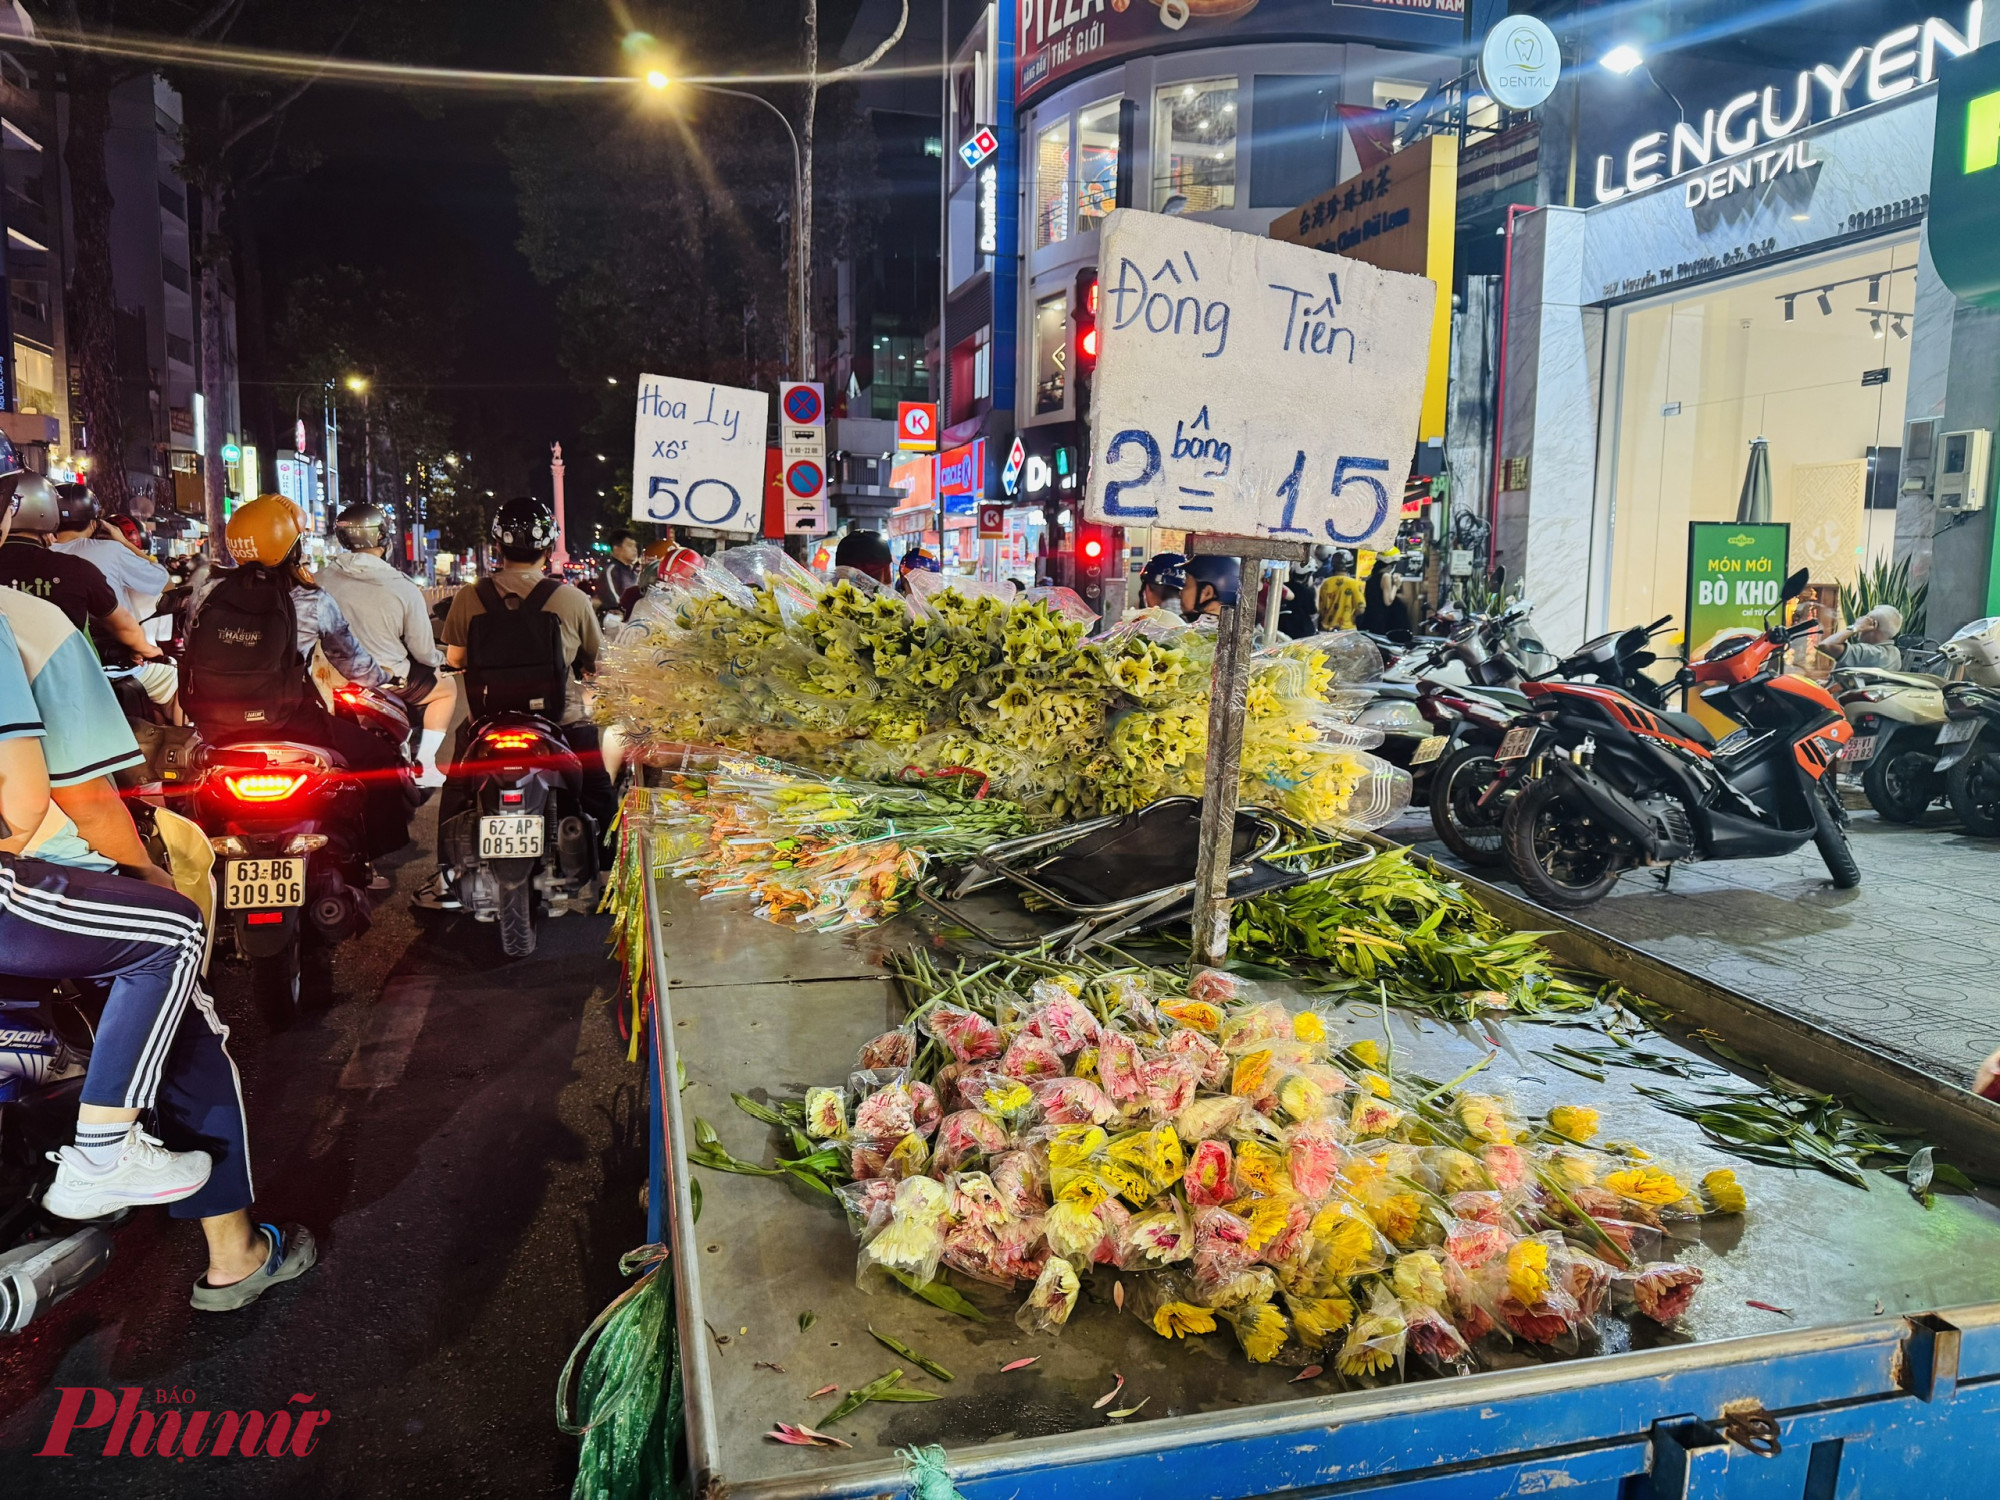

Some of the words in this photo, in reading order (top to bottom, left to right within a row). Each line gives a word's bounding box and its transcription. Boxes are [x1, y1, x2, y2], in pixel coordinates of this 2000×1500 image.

[1021, 0, 1104, 57] PIZZ
[1051, 26, 1073, 68] THẾ
[1076, 20, 1105, 56] GIỚI
[1499, 76, 1551, 88] DENTAL
[1685, 140, 1819, 208] DENTAL
[1108, 250, 1231, 358] Đồng
[1268, 272, 1355, 364] Tiền
[639, 383, 687, 420] Hoa
[941, 463, 962, 488] CIRCLE
[1102, 429, 1161, 518] 2
[1171, 404, 1232, 478] bông
[1262, 449, 1390, 544] 15
[647, 476, 741, 524] 50
[1708, 556, 1740, 572] MÓN
[1745, 556, 1772, 572] MỚI
[1698, 574, 1729, 606] BÒ
[1735, 580, 1779, 606] KHO
[489, 818, 533, 835] 62-AP
[482, 836, 539, 854] 085.55
[237, 860, 293, 881] 63-B6
[229, 882, 301, 905] 309.96
